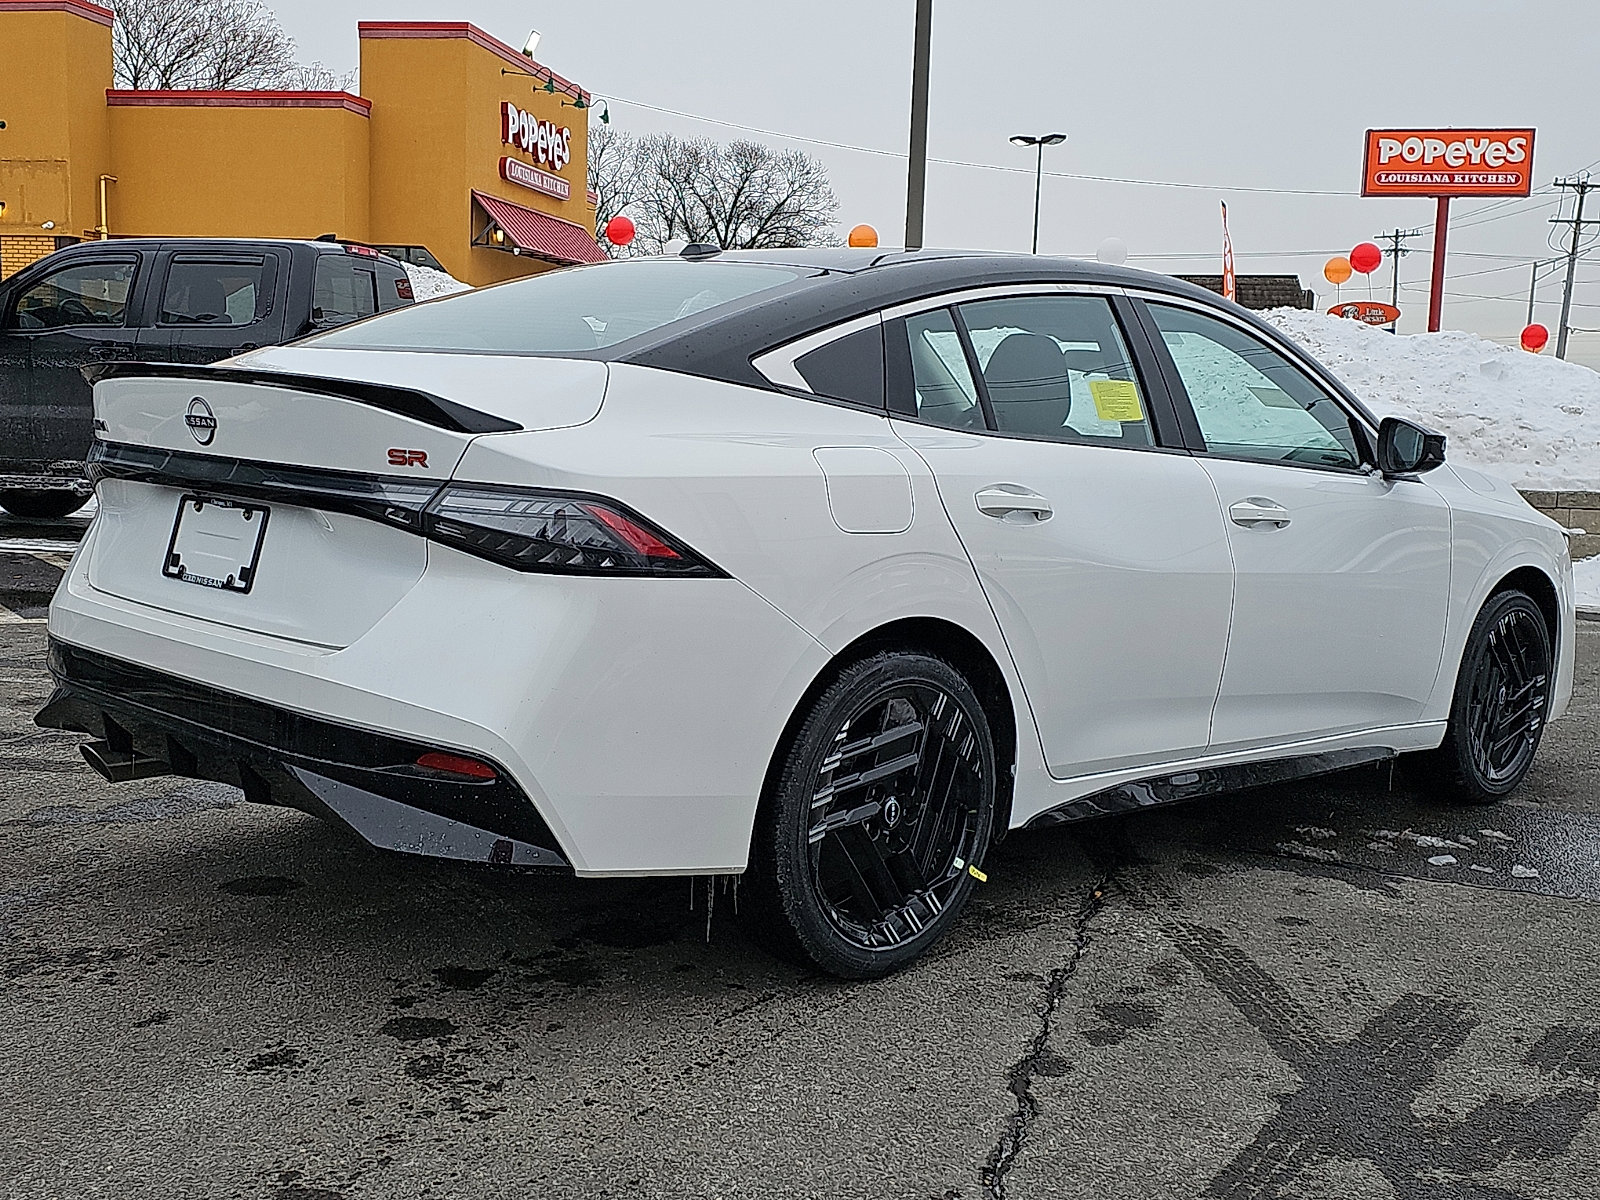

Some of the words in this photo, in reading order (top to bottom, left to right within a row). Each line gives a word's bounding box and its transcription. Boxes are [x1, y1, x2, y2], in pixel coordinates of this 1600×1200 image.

[510, 162, 542, 187] LOUISIANA
[542, 175, 570, 197] KITCHEN
[1380, 173, 1450, 184] LOUISIANA
[1454, 173, 1517, 184] KITCHEN
[387, 448, 430, 469] SR
